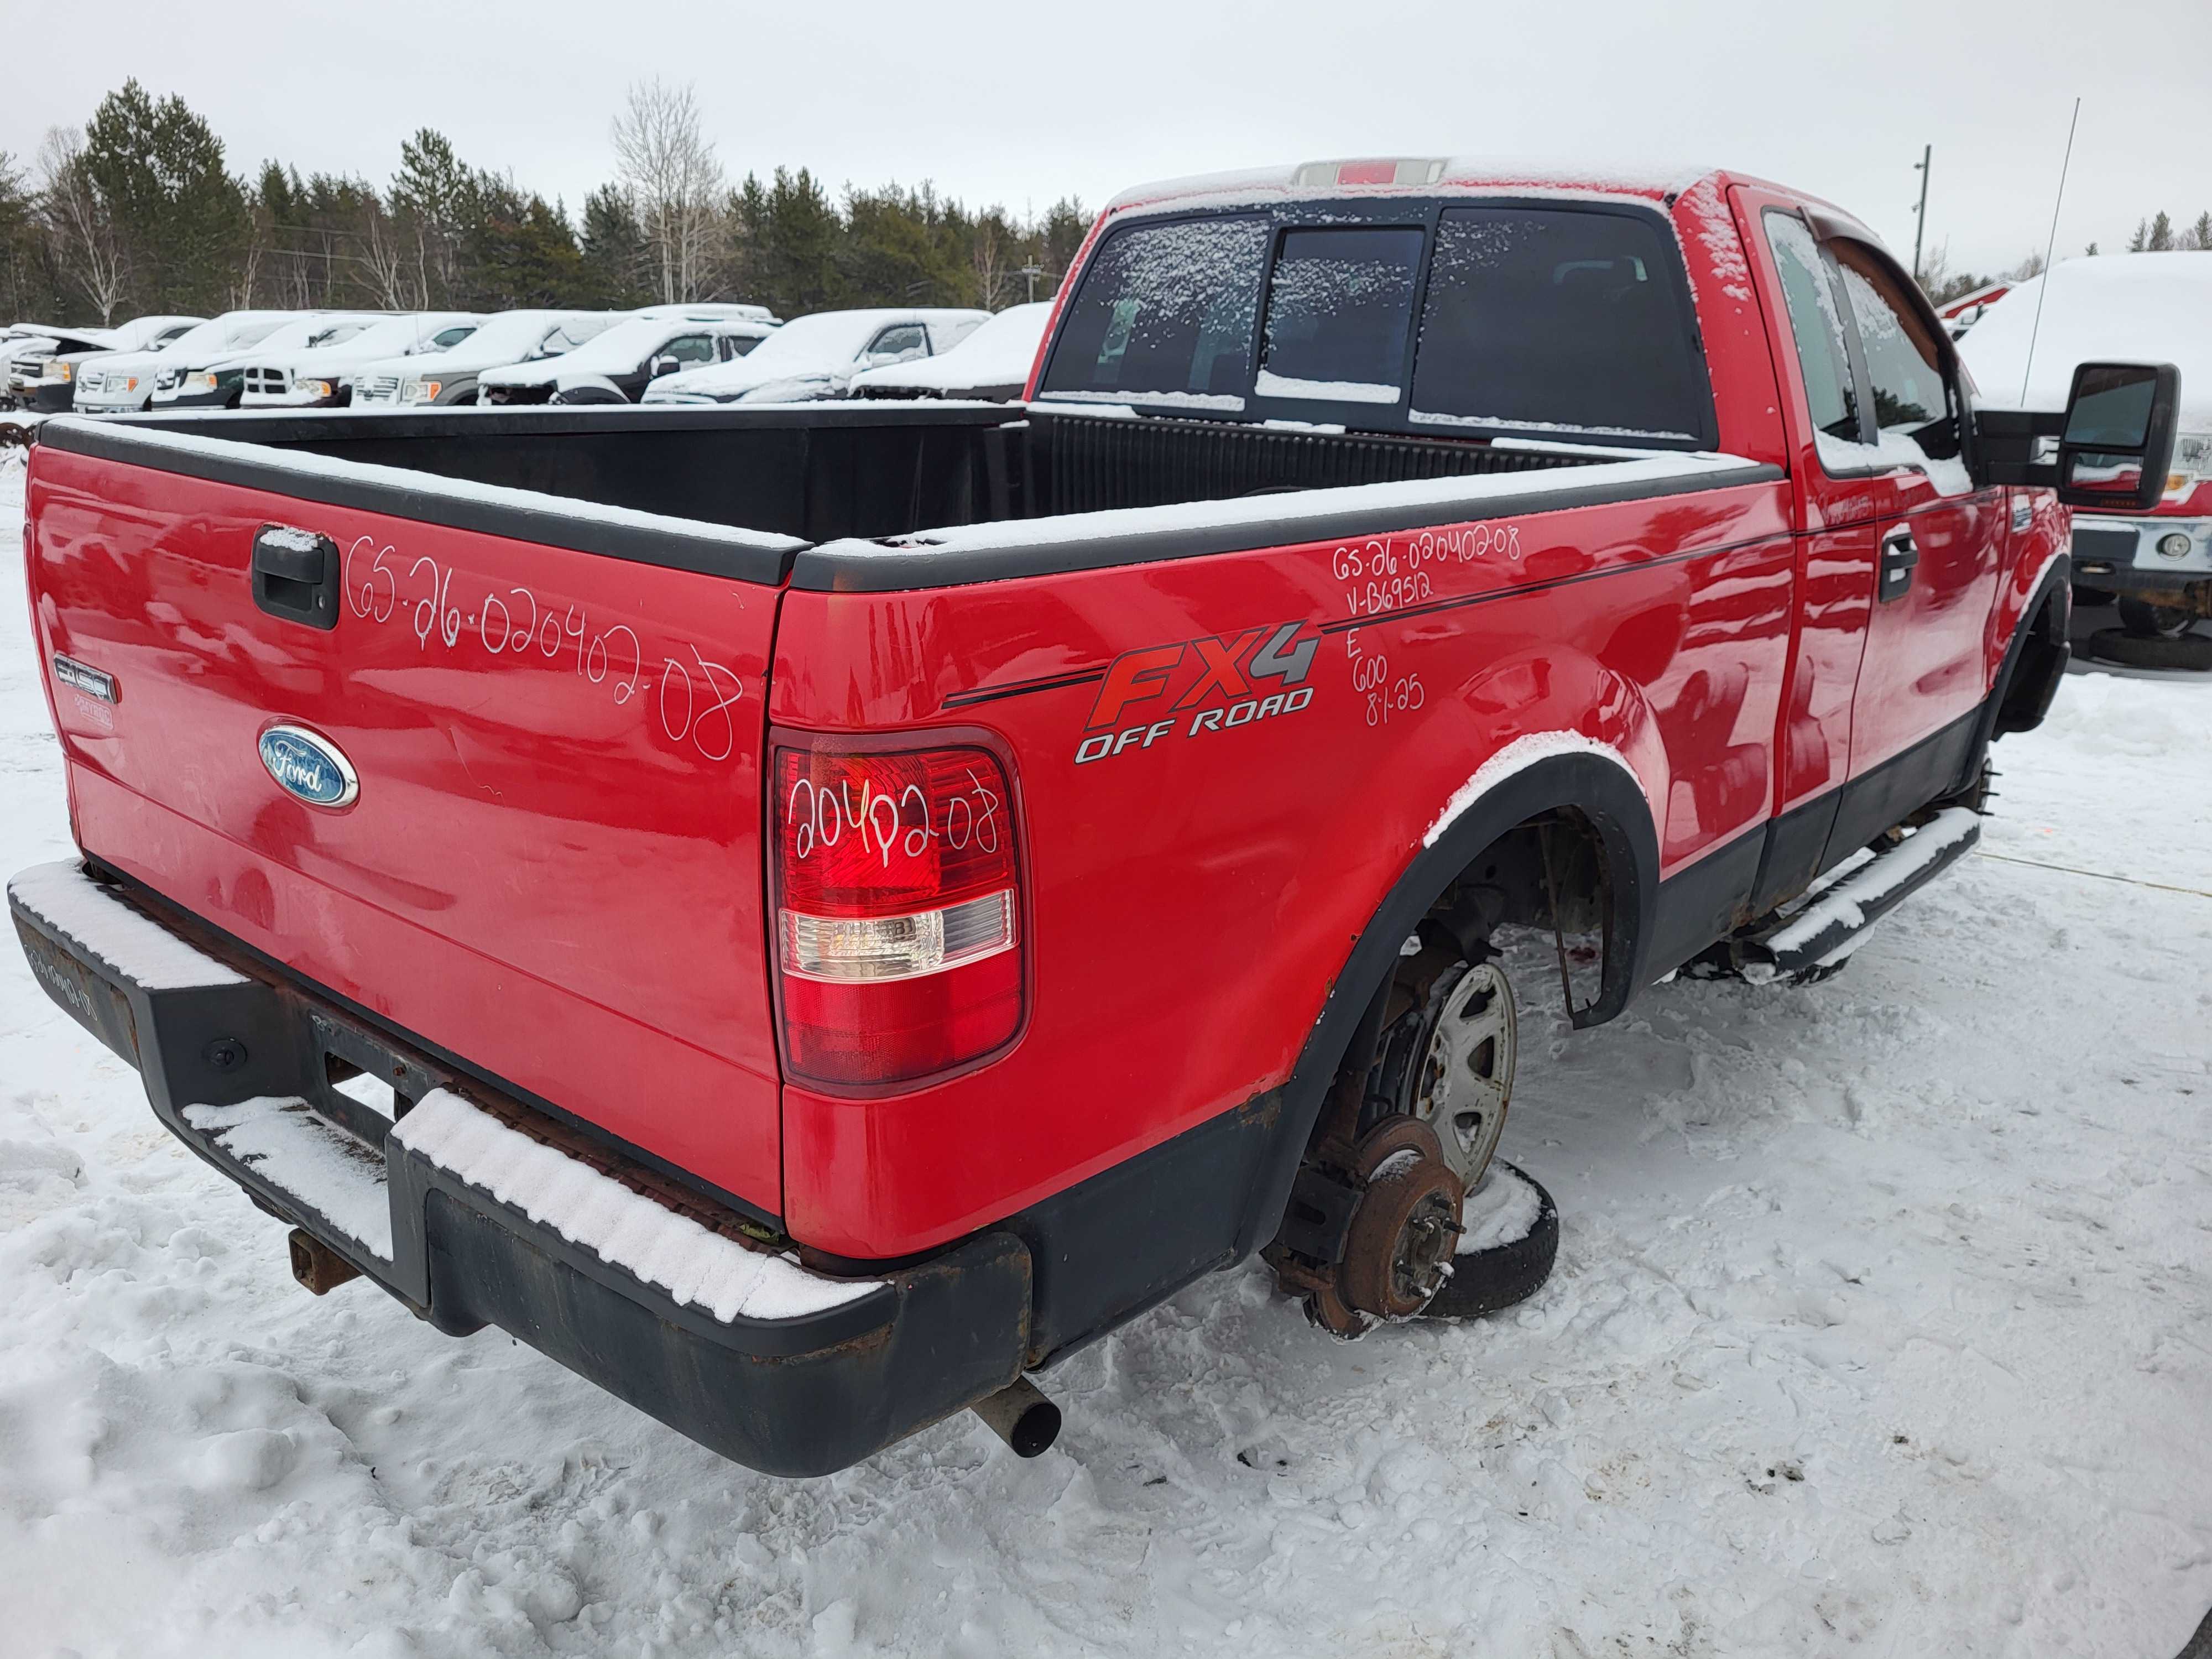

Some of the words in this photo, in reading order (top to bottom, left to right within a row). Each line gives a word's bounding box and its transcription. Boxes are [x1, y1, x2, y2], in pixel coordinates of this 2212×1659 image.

[1347, 628, 1361, 659] E
[1083, 619, 1321, 732] FX4
[1353, 655, 1387, 692] 600
[1074, 717, 1176, 765] OFF
[1187, 687, 1314, 738] ROAD
[273, 740, 322, 792] Ford
